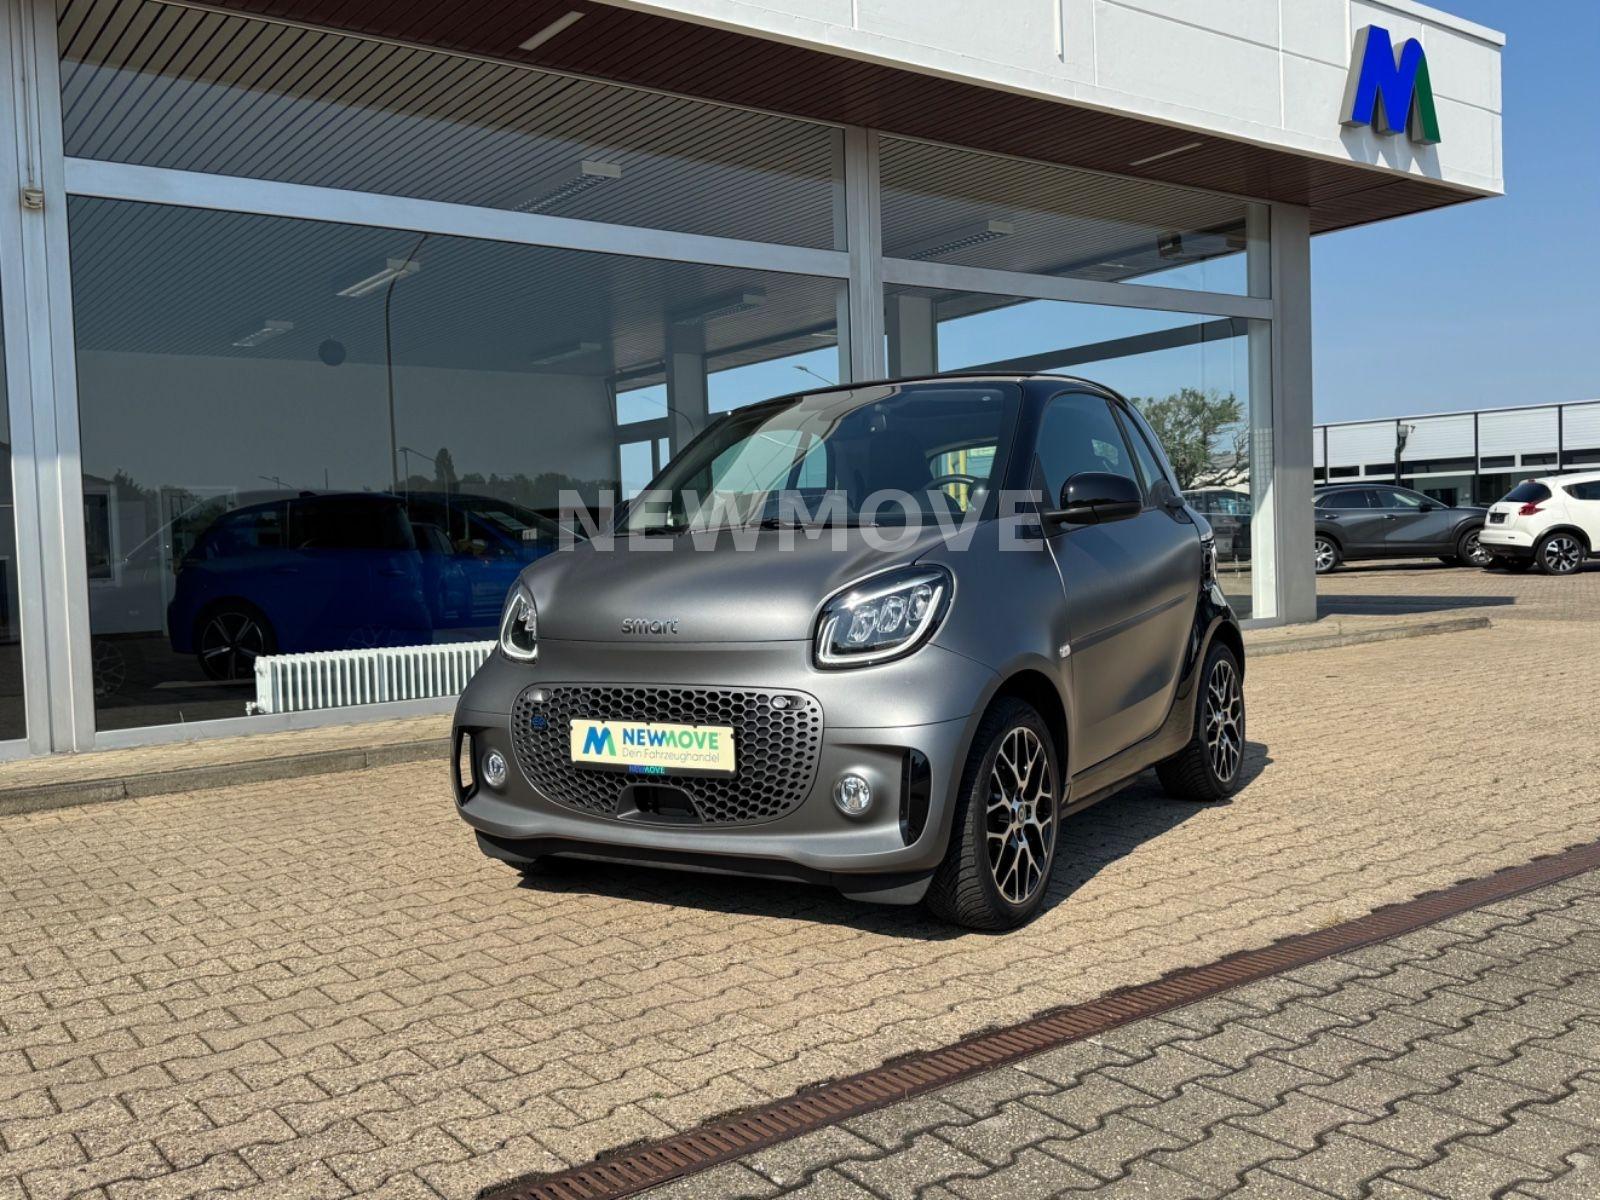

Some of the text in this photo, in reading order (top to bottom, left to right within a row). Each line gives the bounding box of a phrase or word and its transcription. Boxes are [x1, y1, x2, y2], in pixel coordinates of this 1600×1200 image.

[620, 618, 679, 635] smart
[622, 728, 720, 750] NEWMOVE
[622, 748, 720, 763] Dein Fahrzeughandel
